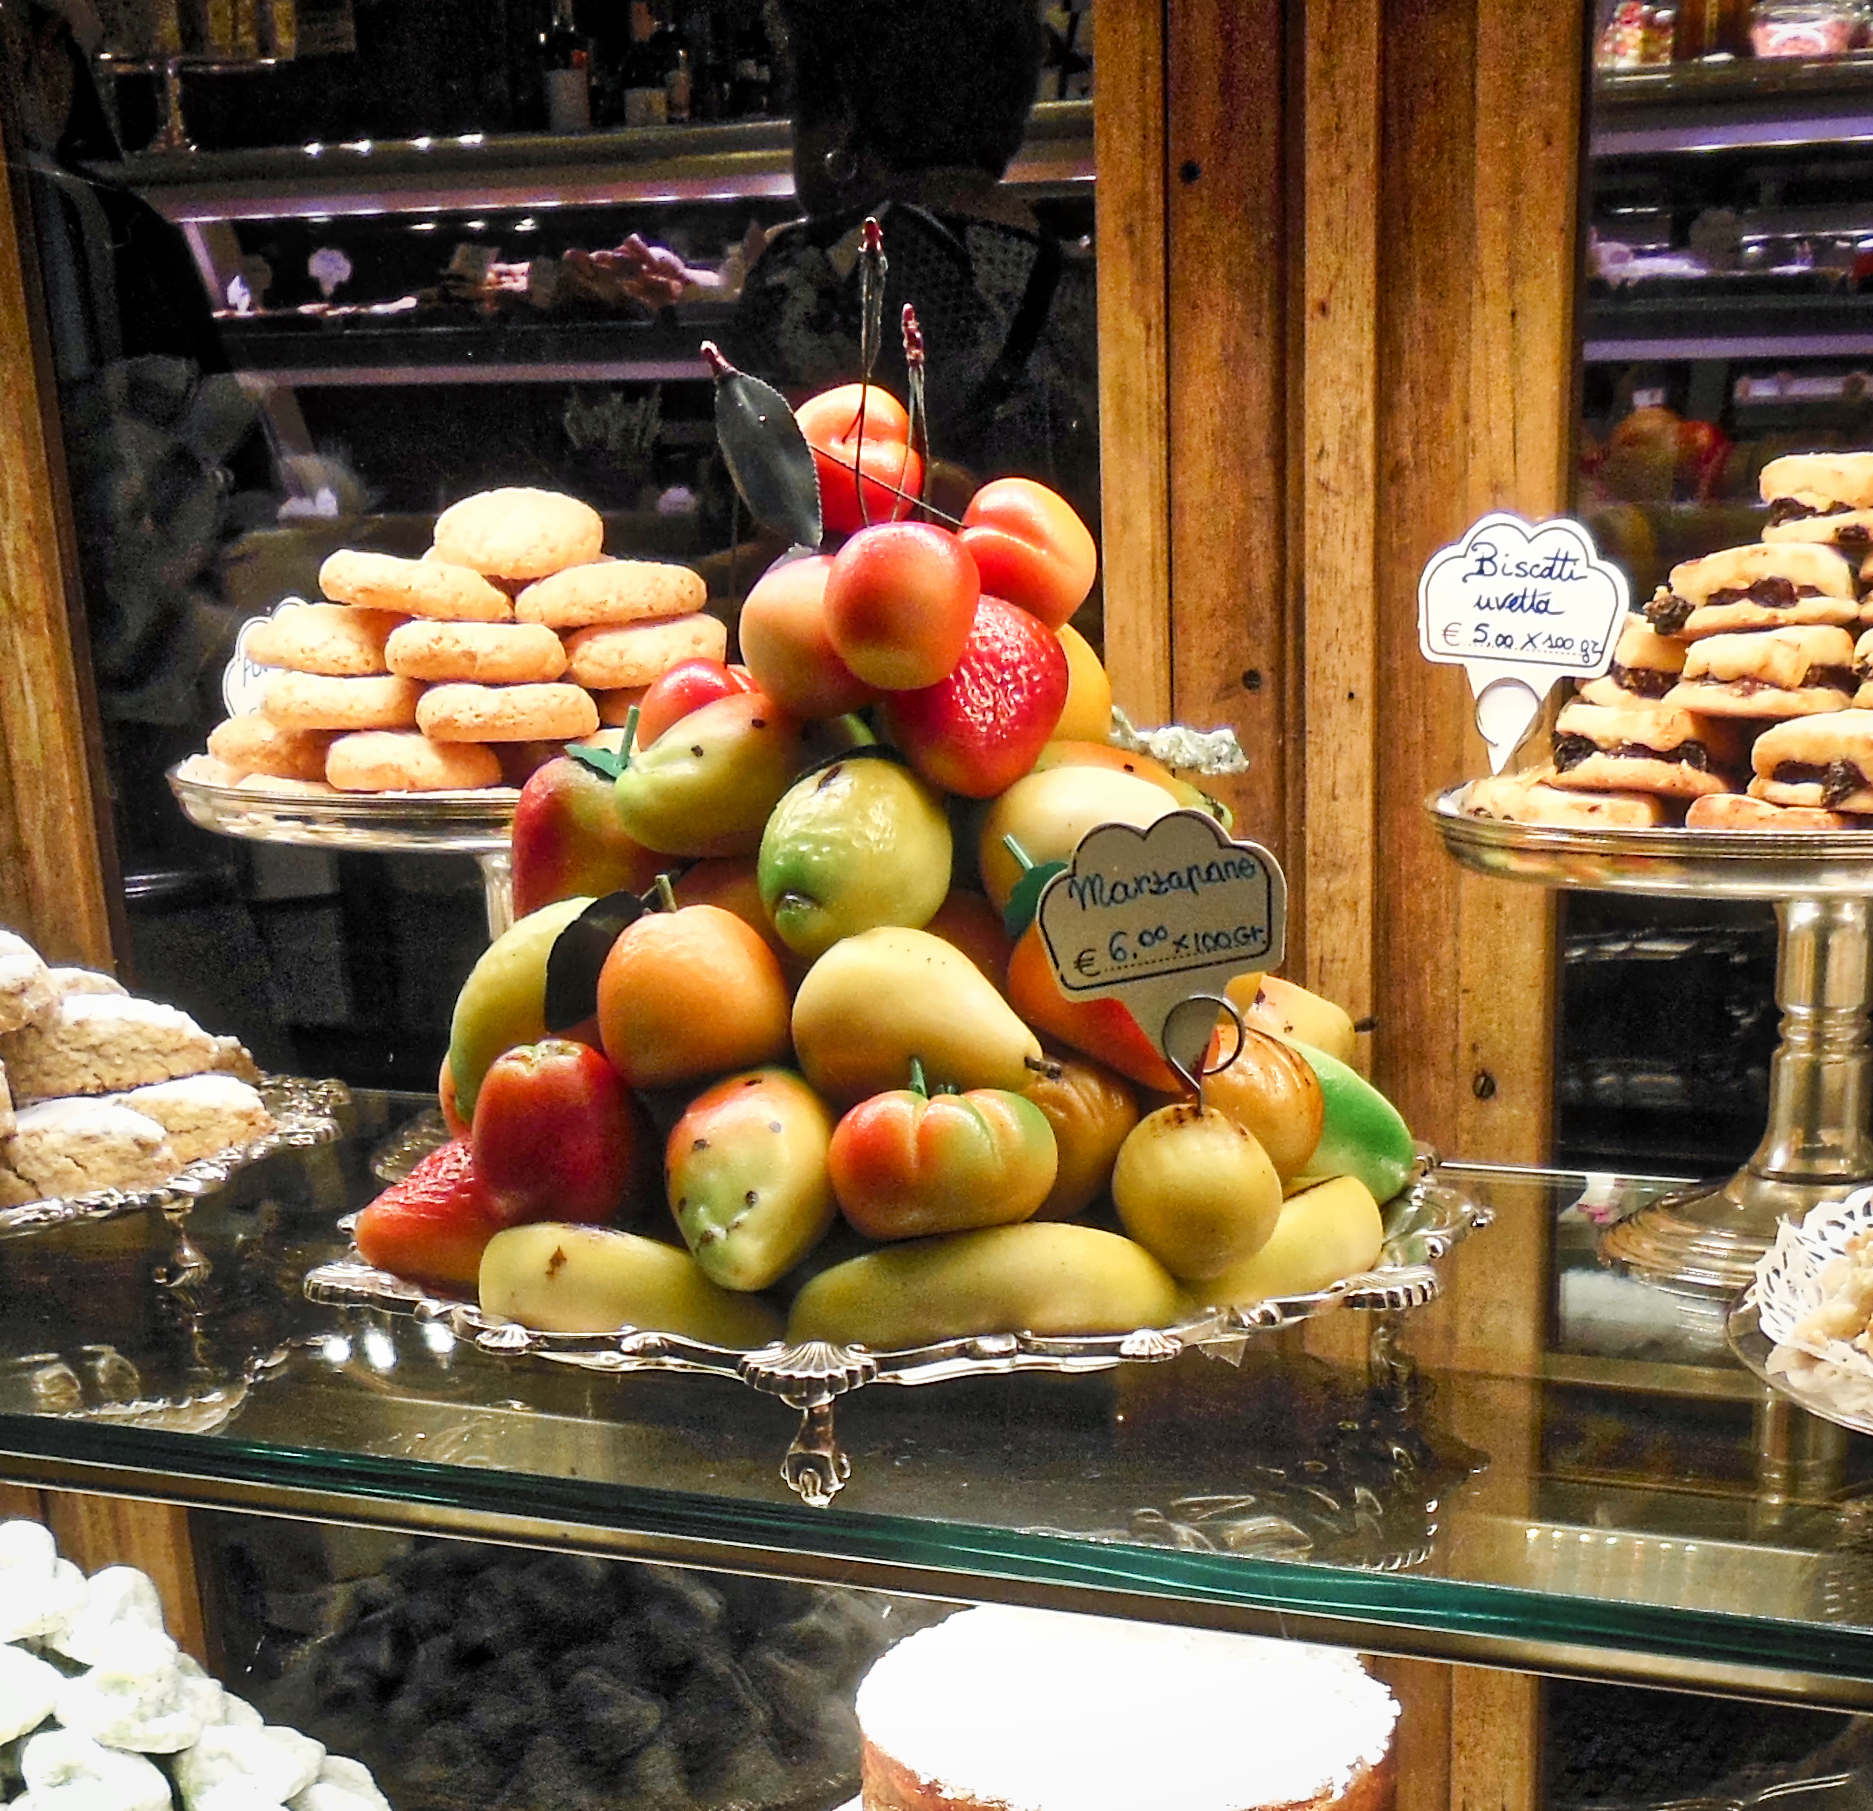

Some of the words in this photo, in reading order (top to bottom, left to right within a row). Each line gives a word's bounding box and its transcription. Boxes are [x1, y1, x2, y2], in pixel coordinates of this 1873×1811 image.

[1462, 541, 1588, 583] Biscotti
[1473, 587, 1565, 615] uvetta
[1442, 622, 1462, 646] €
[1068, 857, 1256, 911] Marzapane
[1073, 949, 1101, 977] €
